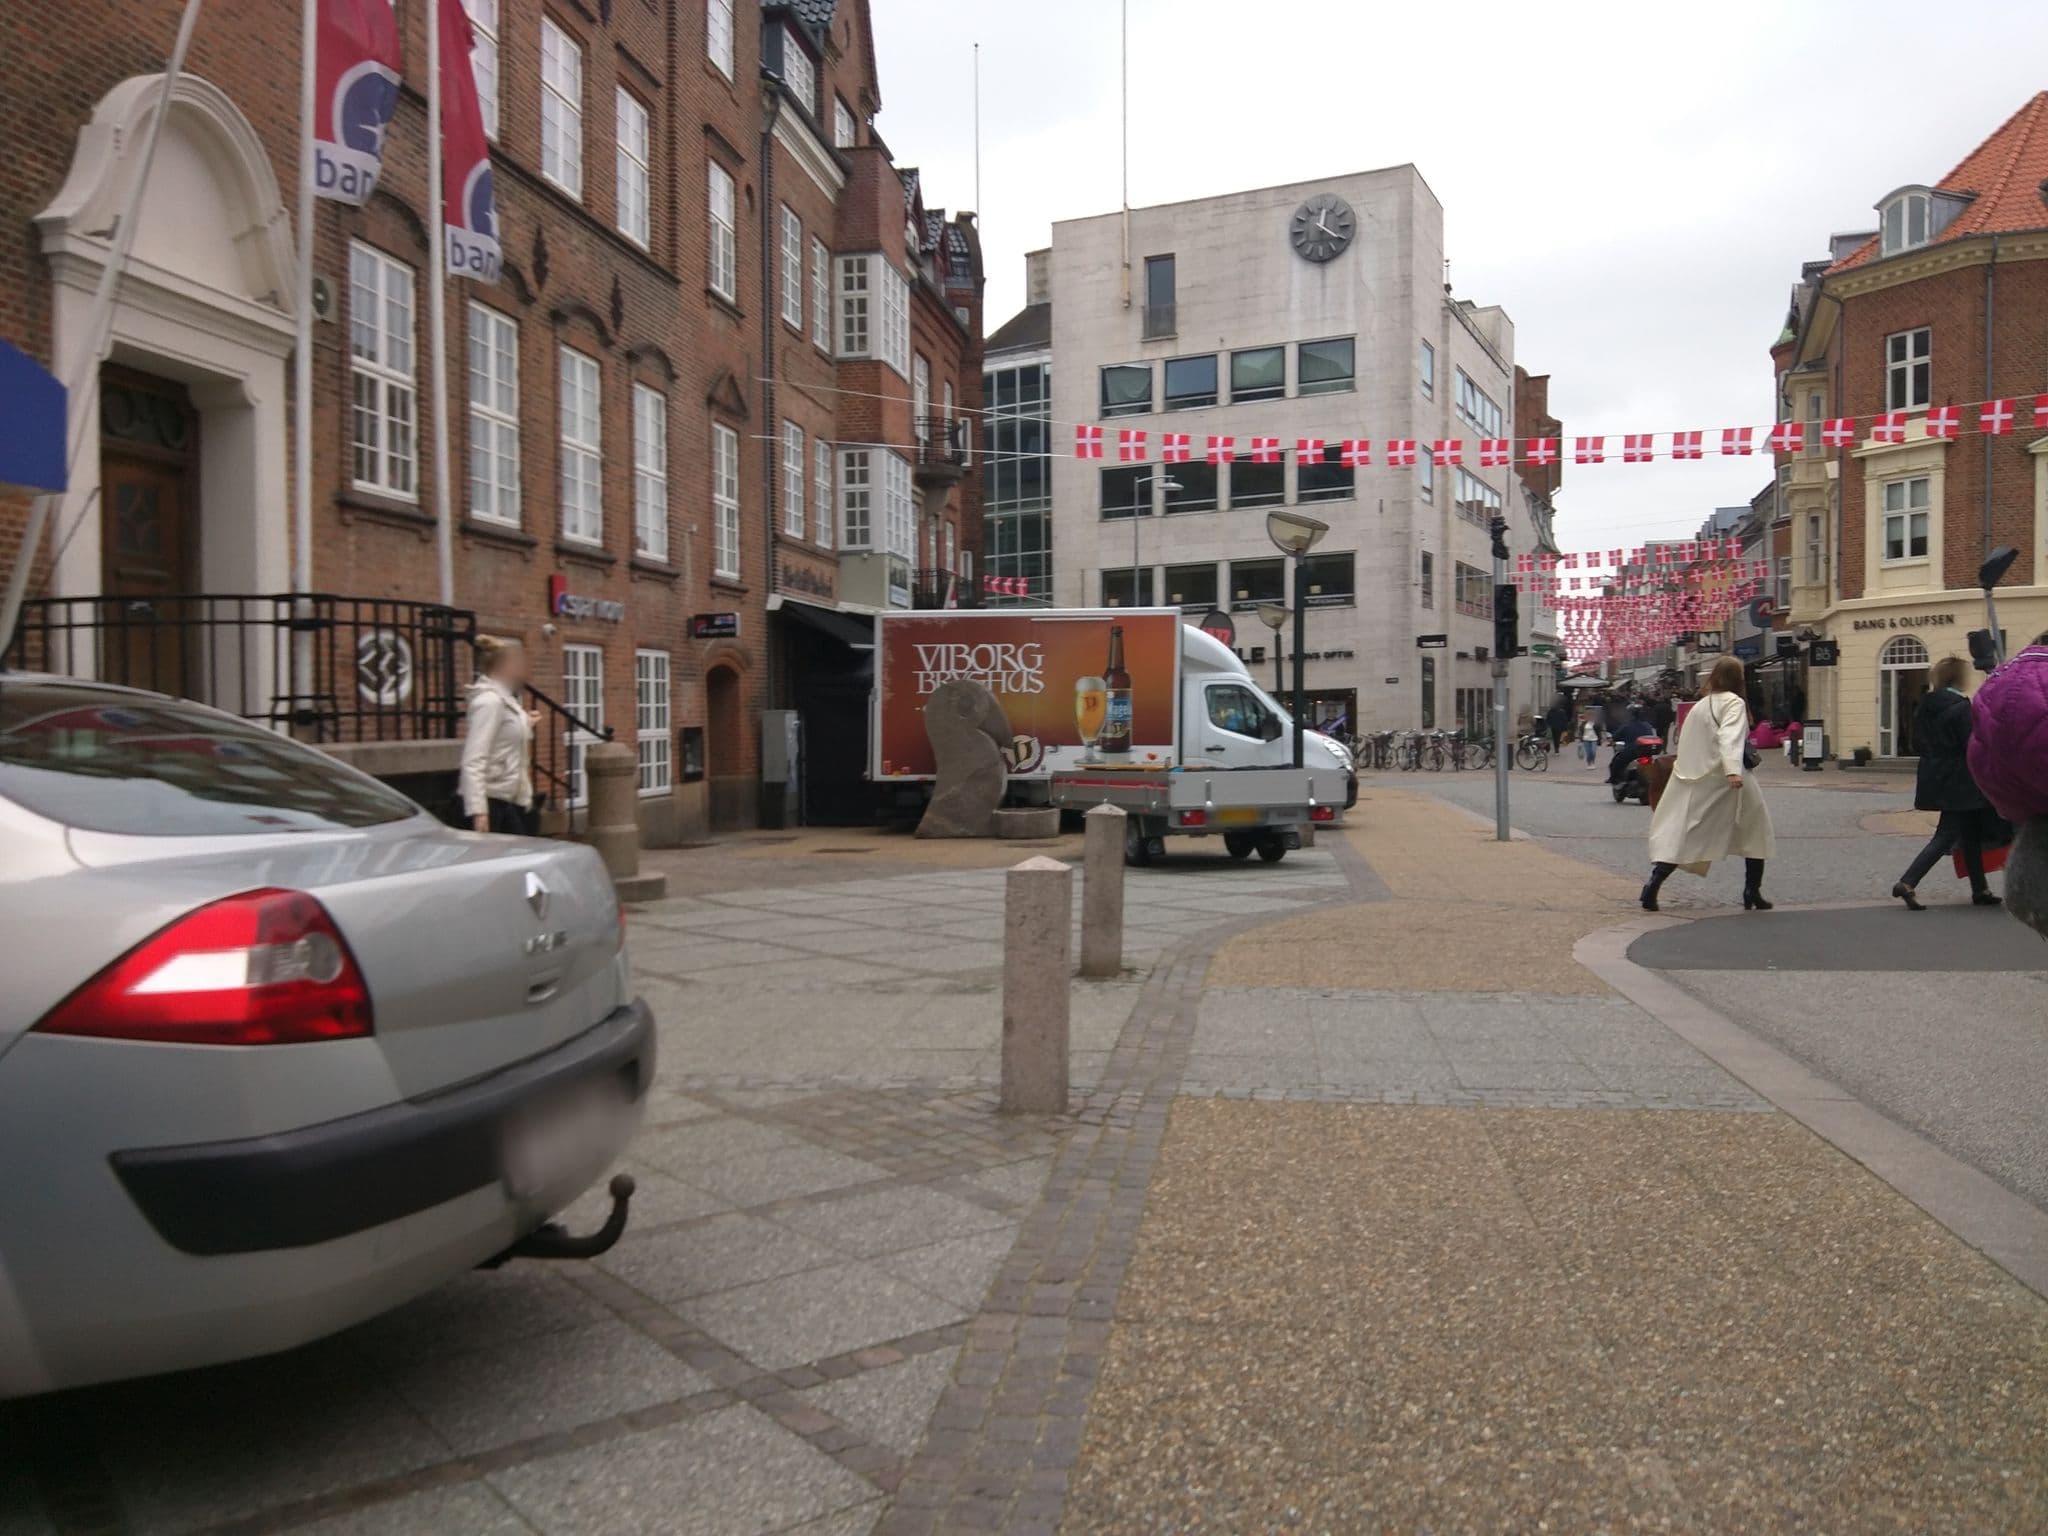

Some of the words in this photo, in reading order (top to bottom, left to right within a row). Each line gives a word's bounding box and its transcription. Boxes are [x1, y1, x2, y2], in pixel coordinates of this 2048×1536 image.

[1853, 618, 1886, 631] BANG
[1889, 617, 1897, 629] &
[1899, 613, 1955, 628] OLUFSEN
[911, 642, 1045, 673] VIBORG
